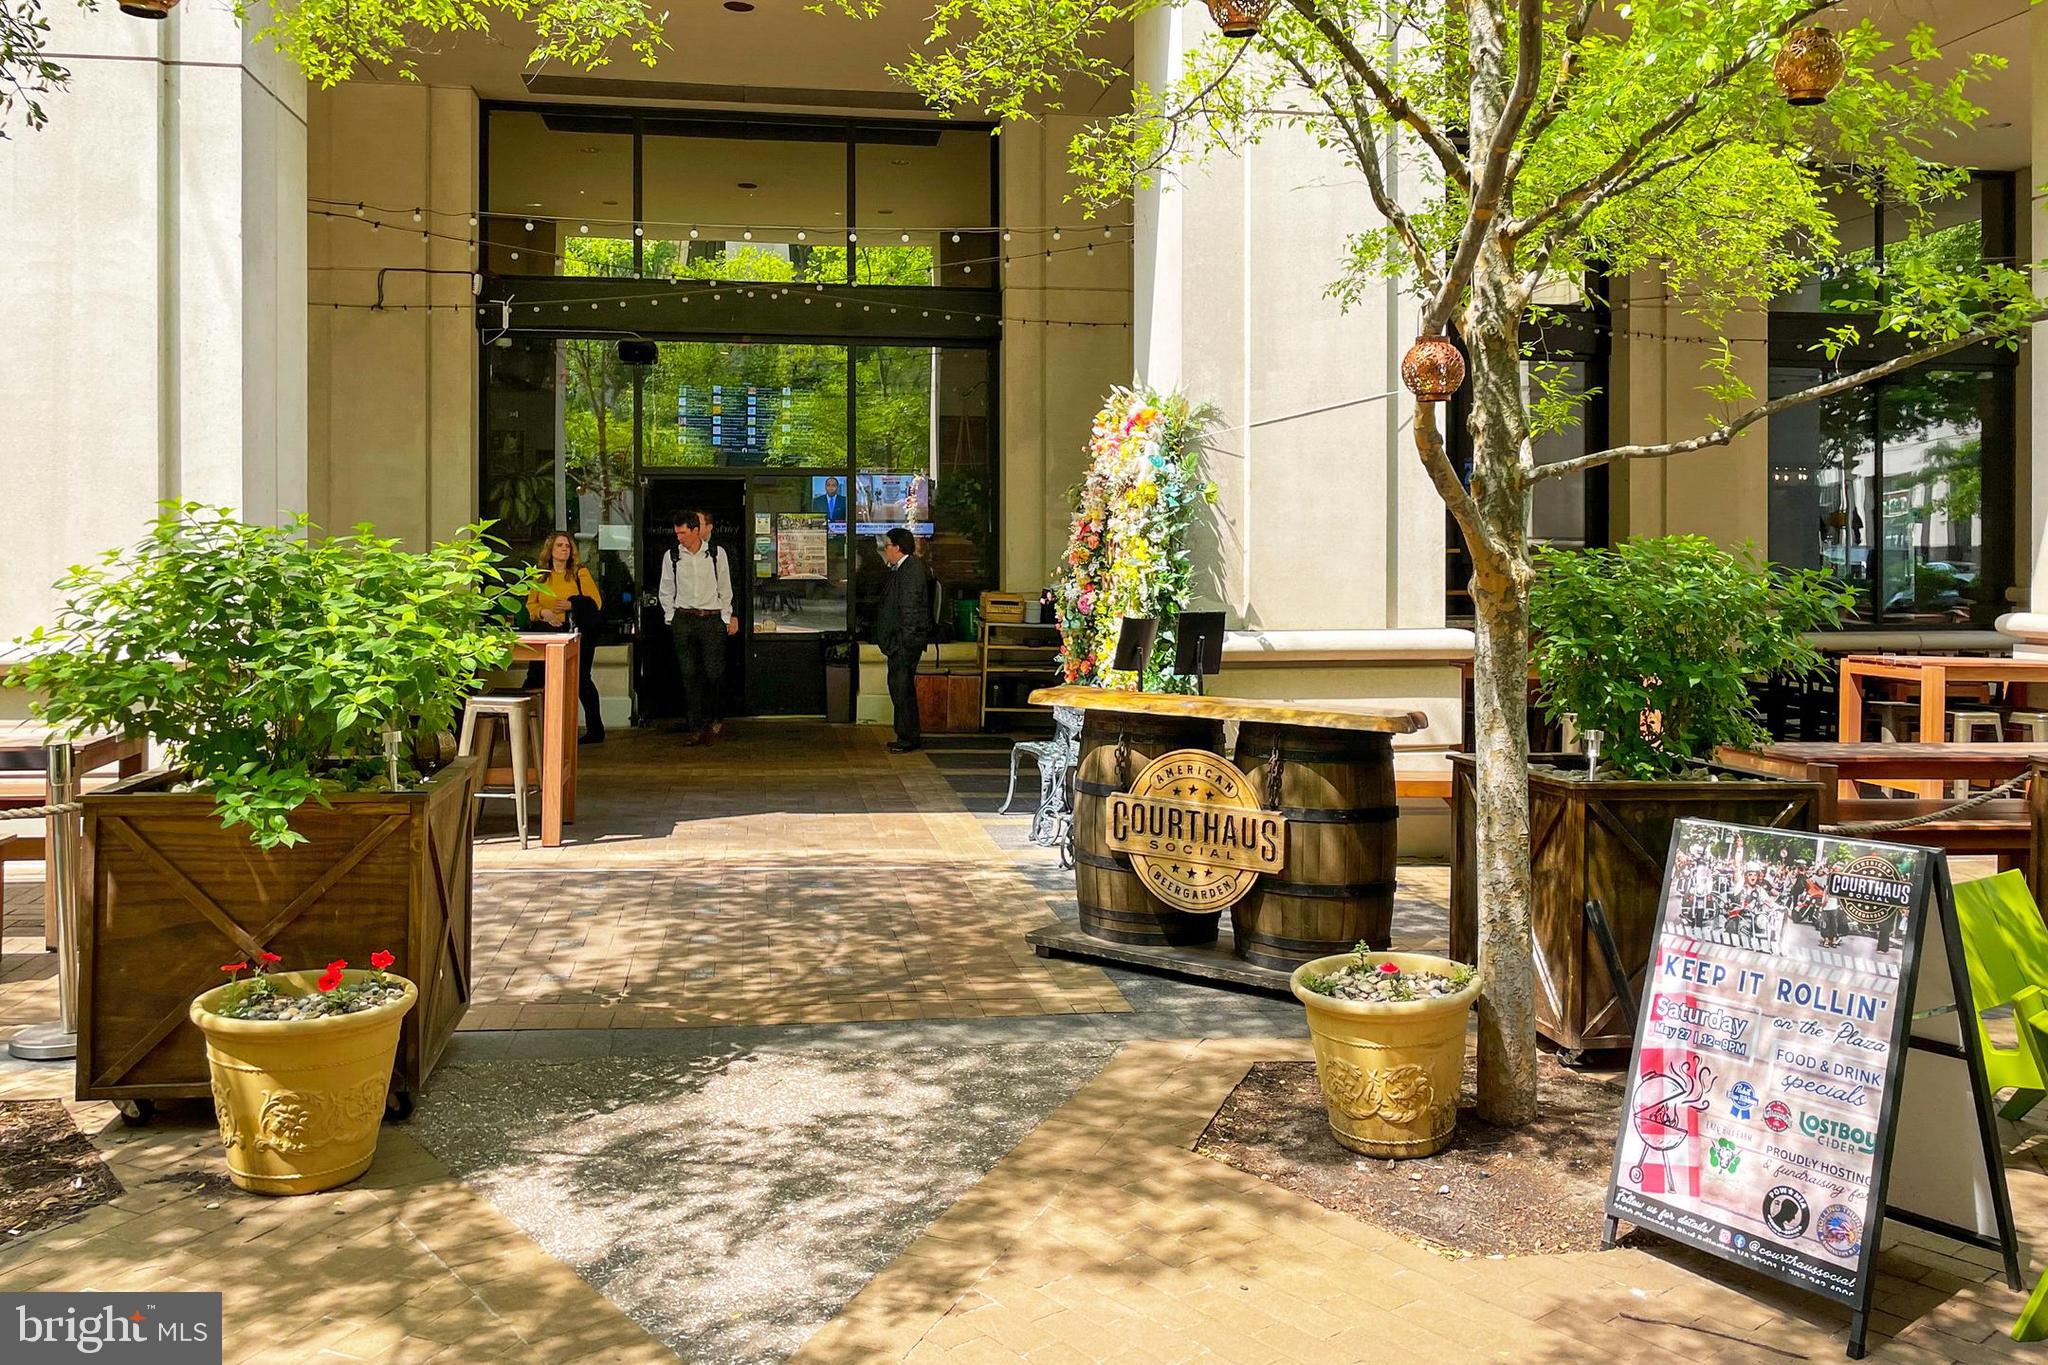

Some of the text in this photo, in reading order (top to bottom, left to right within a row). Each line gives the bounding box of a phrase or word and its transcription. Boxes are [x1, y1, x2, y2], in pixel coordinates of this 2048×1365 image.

[1156, 766, 1233, 793] AMERICAN
[1113, 801, 1278, 862] COURTHAUS
[1150, 840, 1235, 861] SOCIAL
[1856, 860, 1893, 874] AMERICAN
[1153, 871, 1233, 900] BEERGARDEN
[1831, 874, 1911, 904] COURTHAUS
[1848, 892, 1890, 904] SOCIAL
[1664, 955, 1887, 1021] KEEP IT ROLLIN'
[1657, 996, 1748, 1040] Saturday
[1654, 1022, 1676, 1039] May
[1678, 1027, 1691, 1041] 27
[1701, 1034, 1713, 1047] 12
[1721, 1039, 1747, 1056] 9PM
[1773, 1018, 1887, 1052] on the Plaza
[1776, 1049, 1881, 1086] FOOD & DRINK
[1781, 1075, 1868, 1107] specials
[1766, 1145, 1819, 1169] PROUDLY
[1817, 1136, 1855, 1154] CIDER
[1773, 1165, 1846, 1198] fundraising
[1615, 1189, 1645, 1208] Follow
[1646, 1205, 1658, 1215] us
[1658, 1209, 1675, 1221] for
[1677, 1215, 1715, 1234] details!
[1769, 1187, 1807, 1209] POW MIA
[1749, 1240, 1857, 1288] @courthaussocial
